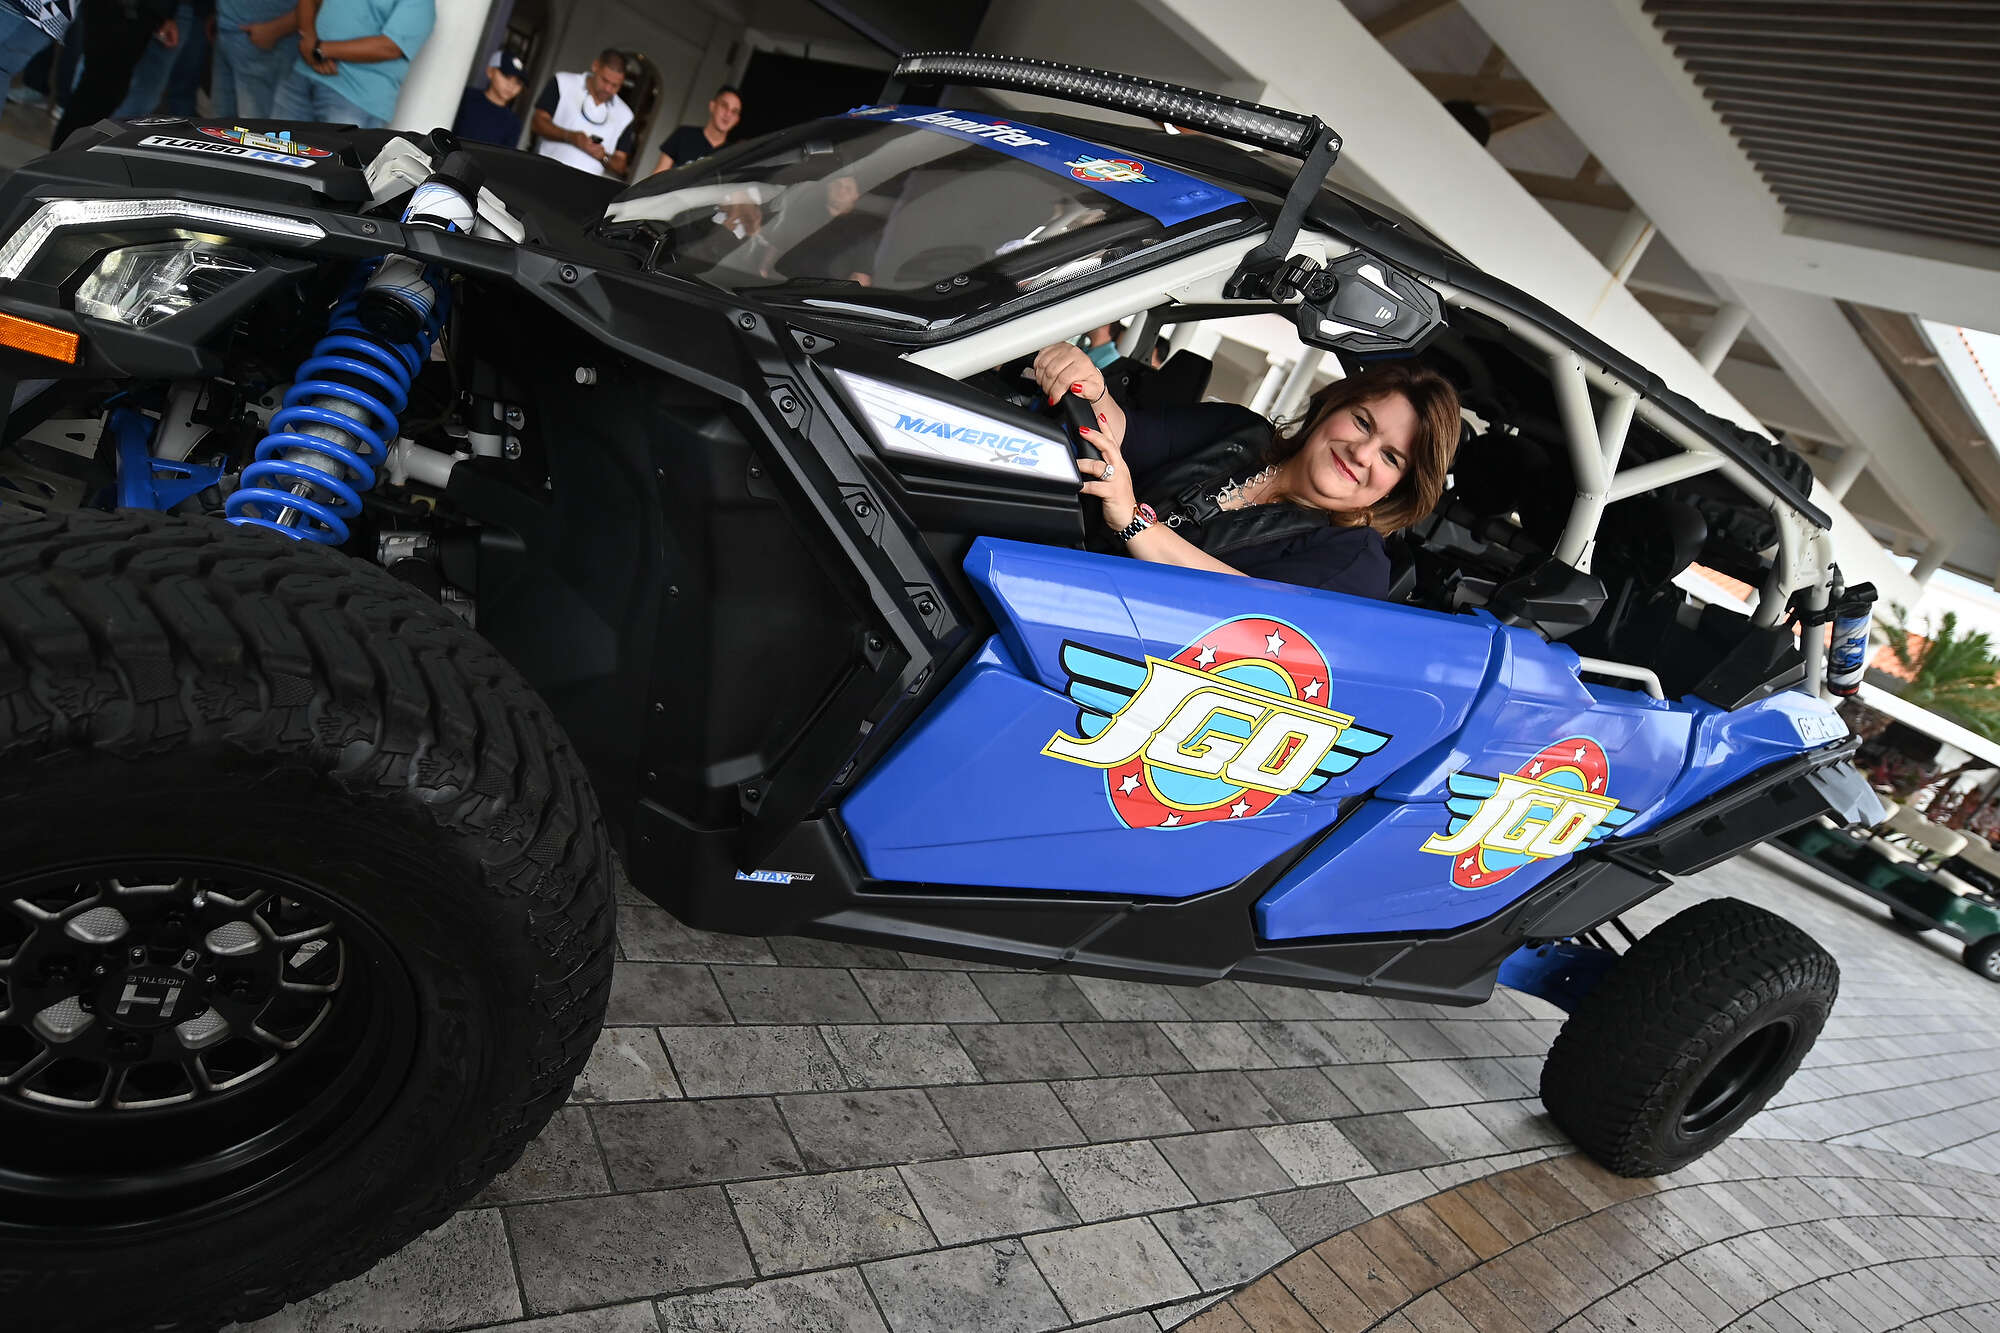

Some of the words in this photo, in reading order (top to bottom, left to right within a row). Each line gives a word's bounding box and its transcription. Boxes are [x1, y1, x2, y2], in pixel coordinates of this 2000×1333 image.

[152, 136, 249, 155] TURBO
[251, 150, 307, 166] RR
[895, 414, 1043, 456] MAVERICK
[1040, 654, 1356, 796] JGO
[1419, 772, 1620, 858] JGO
[127, 975, 186, 986] HOSTILE
